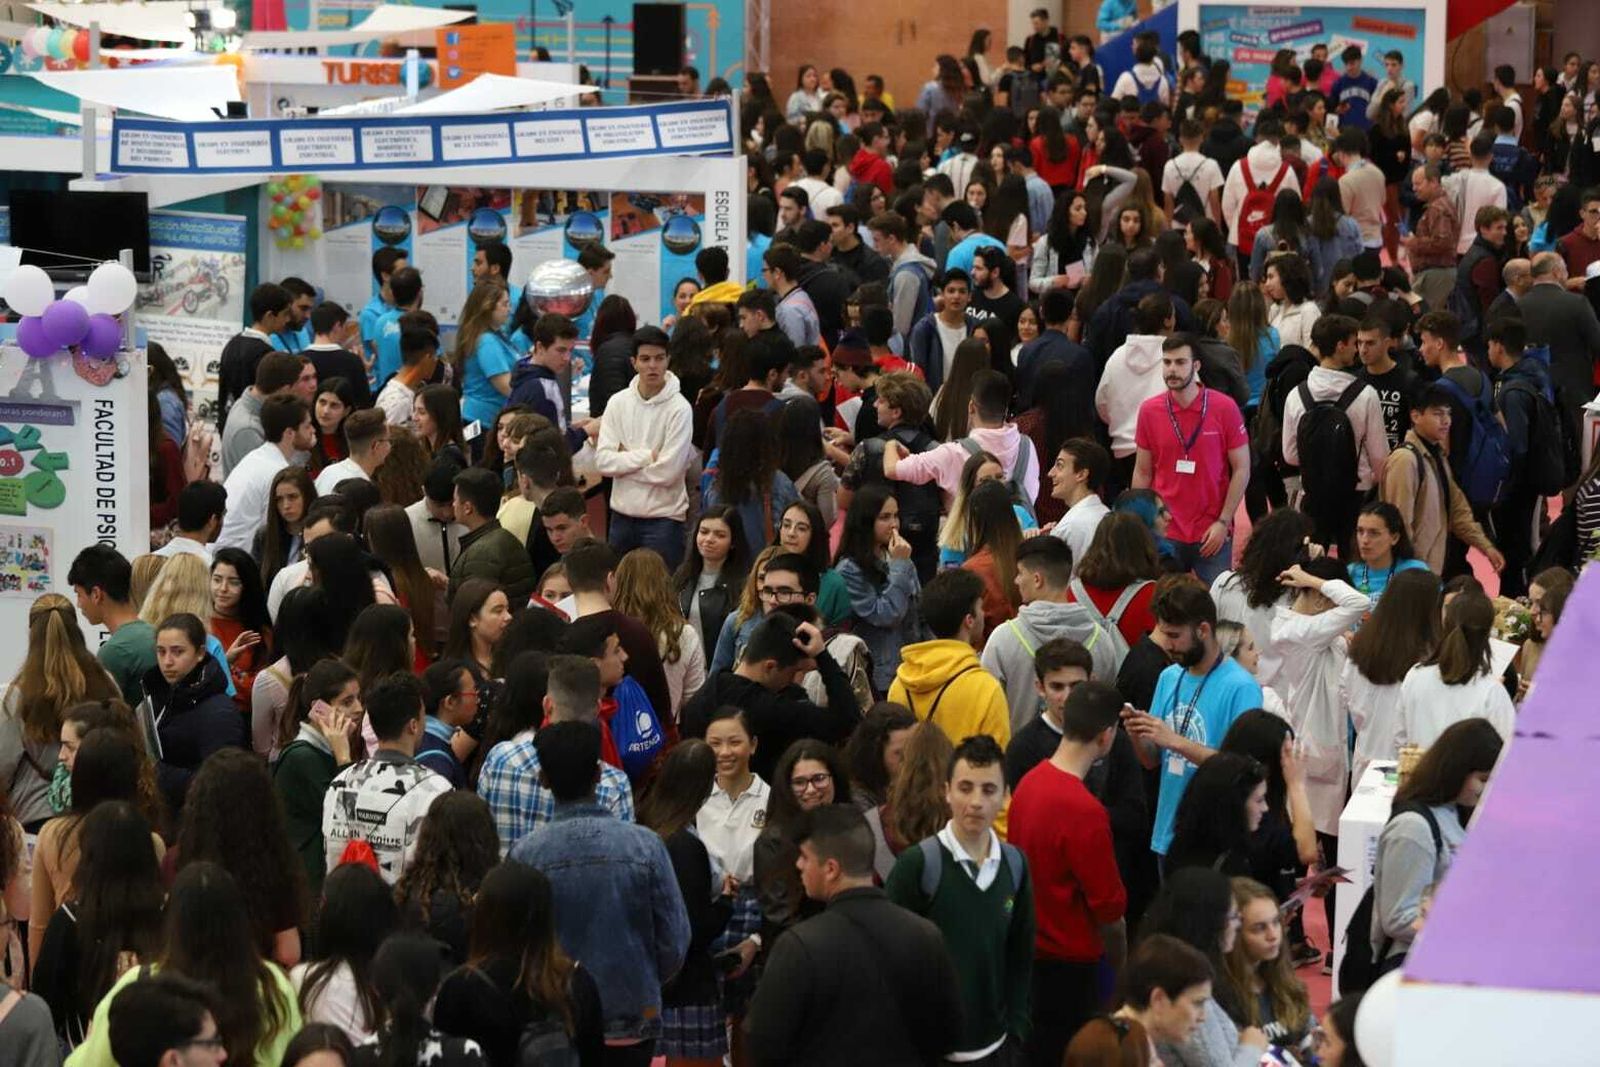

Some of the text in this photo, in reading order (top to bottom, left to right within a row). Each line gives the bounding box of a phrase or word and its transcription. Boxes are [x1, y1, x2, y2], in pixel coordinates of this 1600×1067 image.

[715, 190, 729, 242] ESCUELA
[94, 399, 115, 483] FACULTAD
[96, 487, 116, 509] DE
